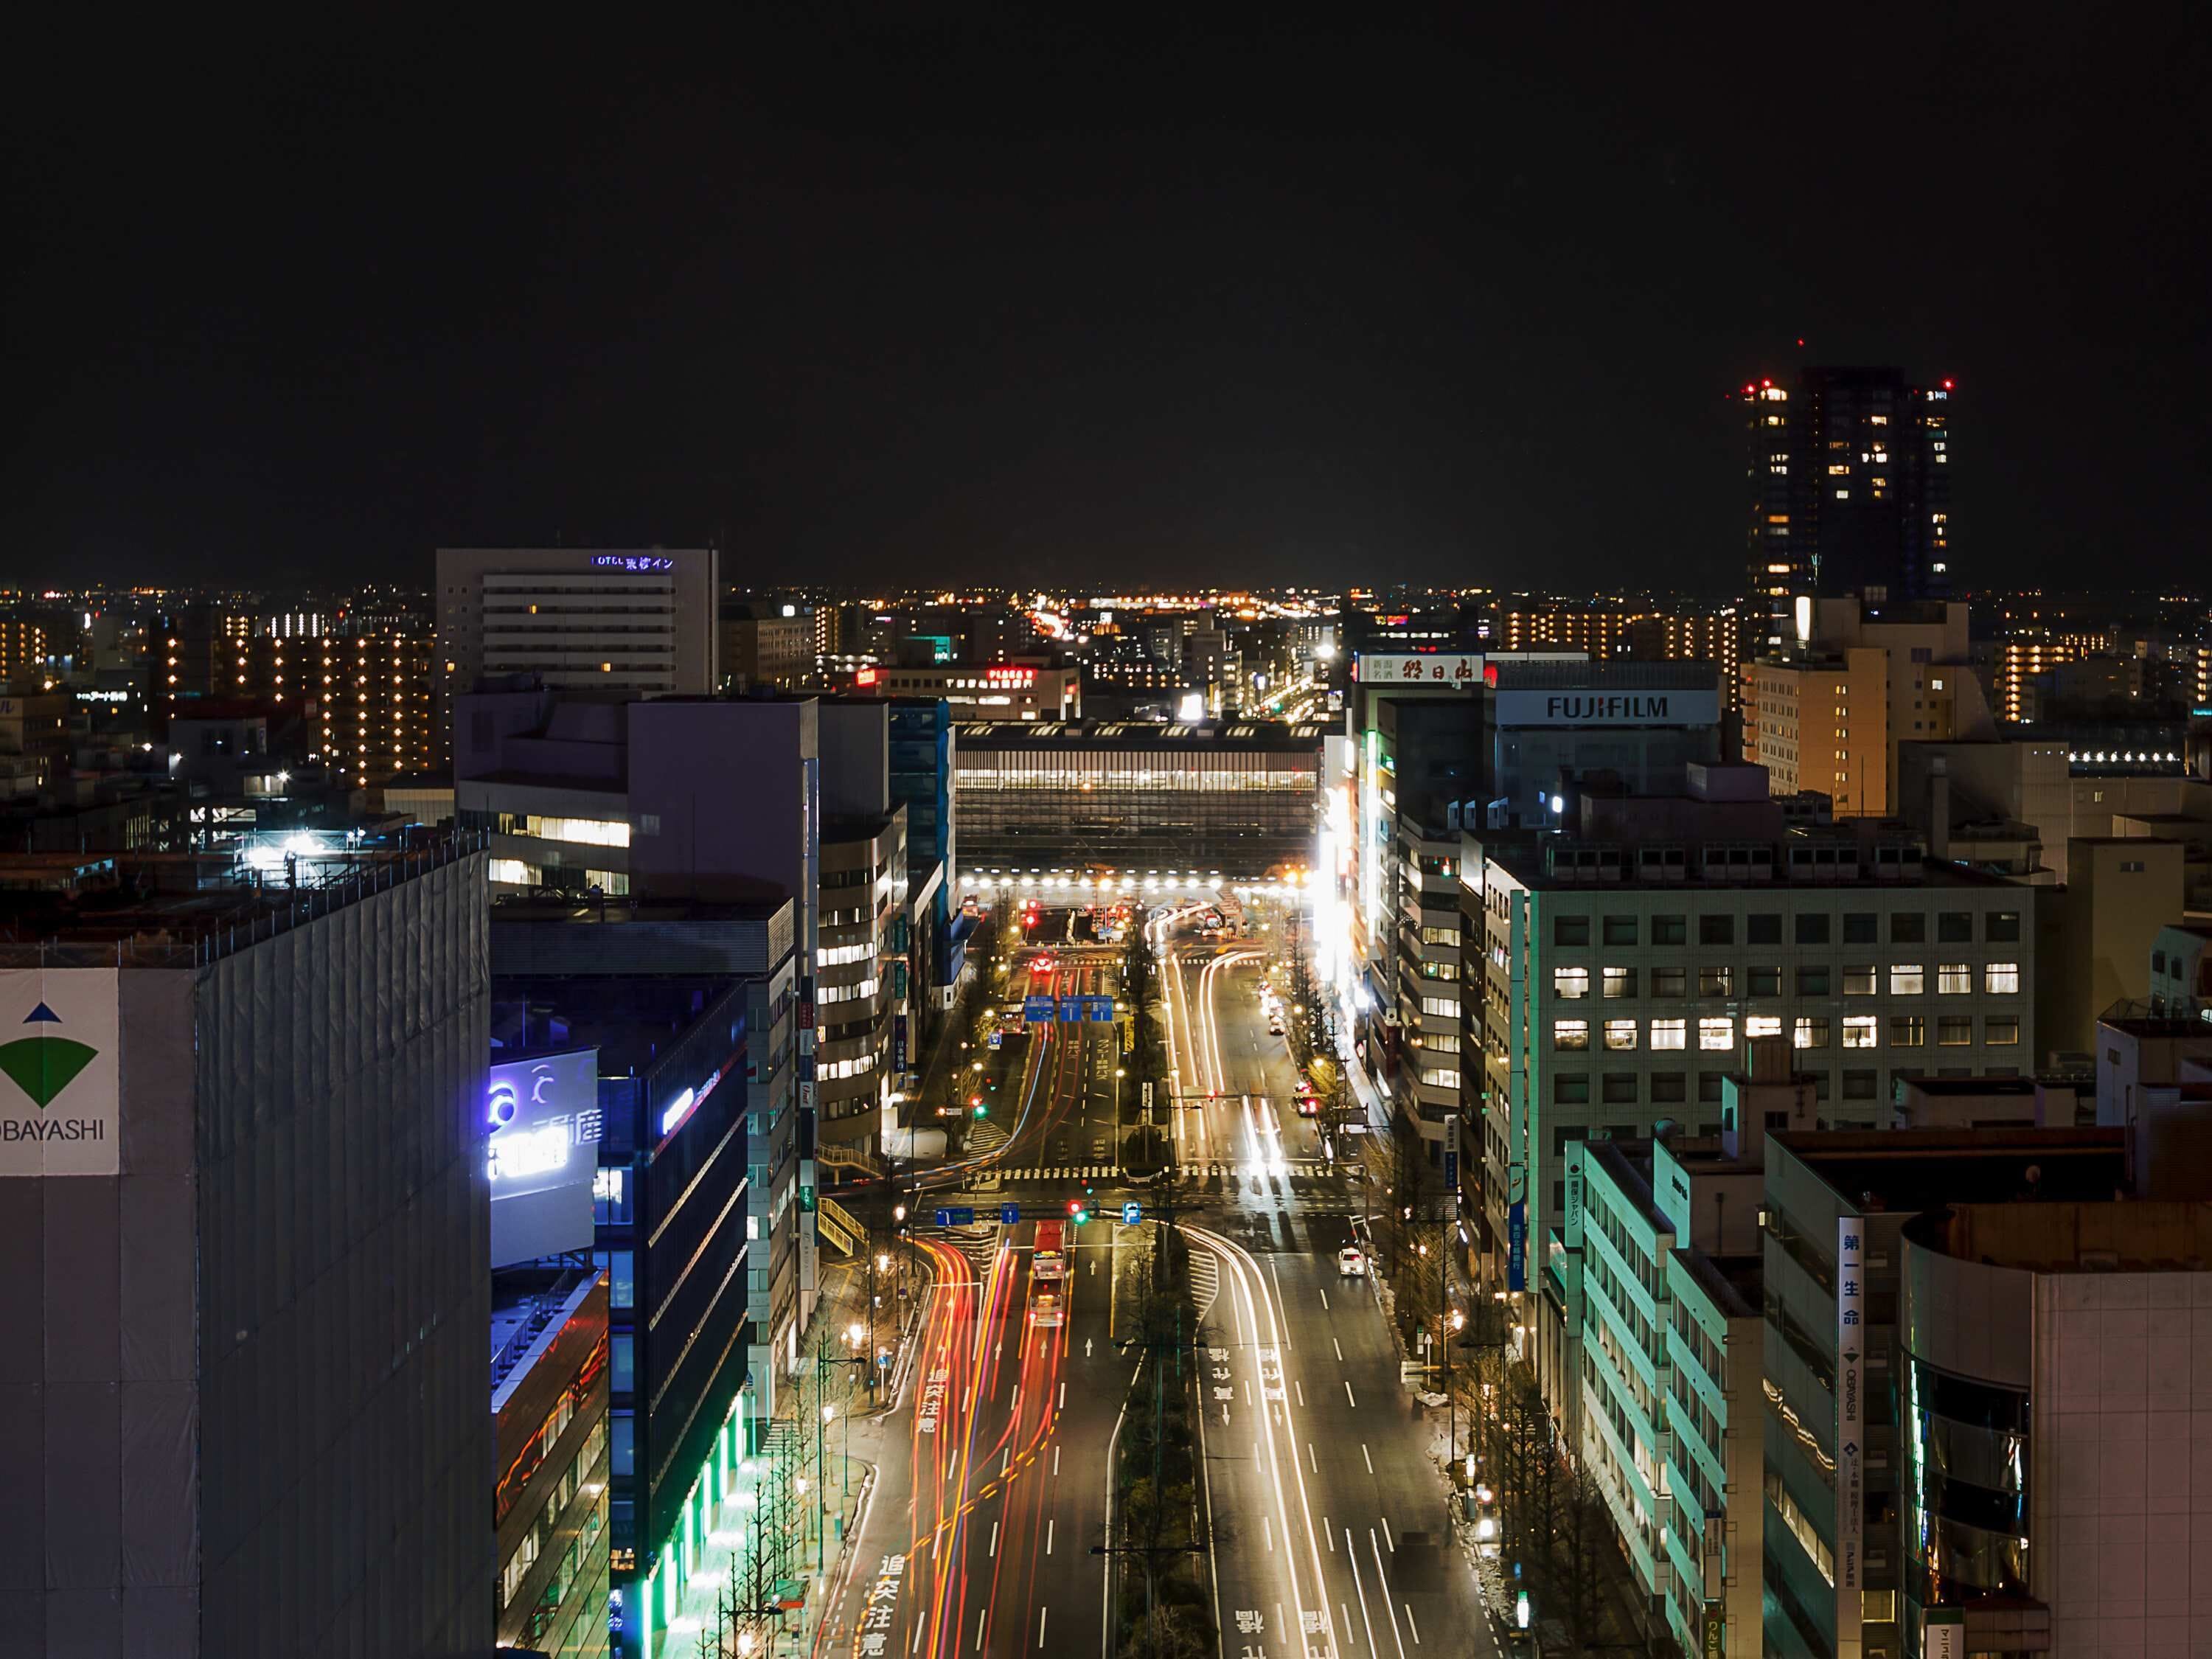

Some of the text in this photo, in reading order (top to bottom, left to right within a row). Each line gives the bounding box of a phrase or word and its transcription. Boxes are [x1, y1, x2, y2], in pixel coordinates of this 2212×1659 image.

[1547, 696, 1668, 718] FUJIFILM
[0, 1119, 104, 1141] BAYASHI
[1843, 1234, 1860, 1326] 第一生命
[1846, 1368, 1857, 1422] OBAYASHI
[859, 1554, 906, 1658] 追突注意
